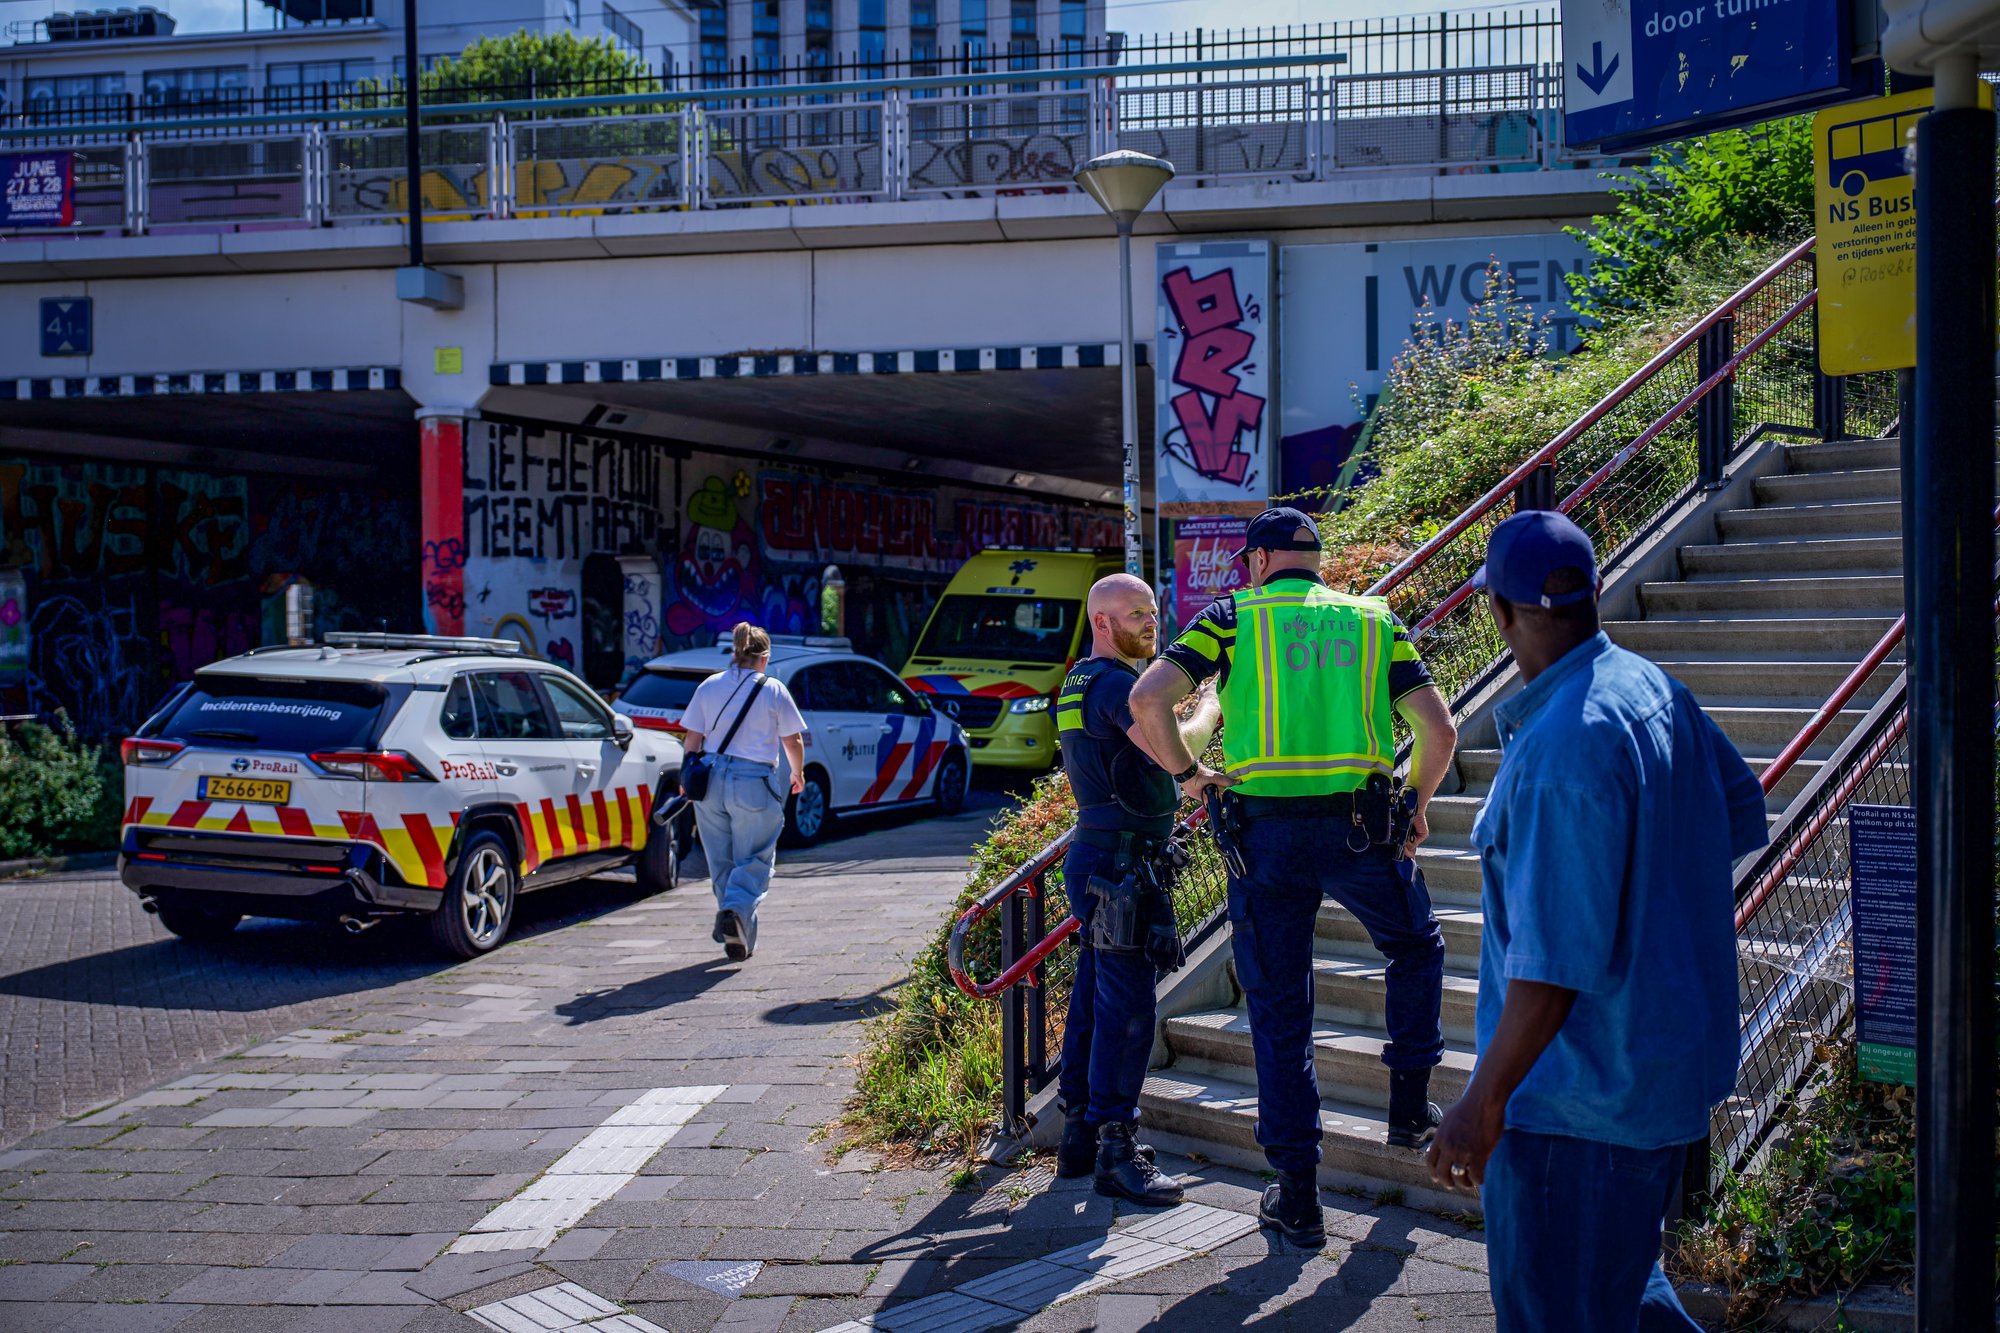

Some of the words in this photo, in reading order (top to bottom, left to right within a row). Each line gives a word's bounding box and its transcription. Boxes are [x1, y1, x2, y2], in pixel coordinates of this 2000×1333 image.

[1645, 6, 1705, 37] door
[14, 160, 57, 178] JUNE
[6, 178, 25, 195] 27
[43, 176, 62, 193] 28
[1829, 200, 1860, 224] NS
[1868, 189, 1917, 217] Bus
[1853, 223, 1883, 234] Alleen
[1886, 220, 1895, 229] in
[1897, 216, 1917, 229] geb
[1832, 234, 1891, 250] verstoringen
[1894, 231, 1903, 240] in
[1837, 252, 1849, 261] en
[1852, 247, 1884, 260] tijdens
[1886, 242, 1917, 254] werkz
[1179, 522, 1217, 530] LAATSTE
[1286, 638, 1357, 671] OVD
[924, 665, 1016, 676] AMBULANCE
[200, 701, 342, 721] Incidentenbestrijding
[841, 744, 876, 757] POLITIE
[252, 759, 298, 774] ProRail
[440, 760, 499, 781] ProRail
[210, 779, 284, 801] Z-666-DR
[1853, 810, 1879, 818] ProRail
[1891, 811, 1901, 819] NS
[1903, 811, 1916, 820] Sta
[1854, 818, 1882, 827] welkom
[1884, 820, 1893, 828] op
[1895, 820, 1905, 828] dit
[1861, 1045, 1871, 1054] Bij
[1872, 1048, 1902, 1057] ongeval
